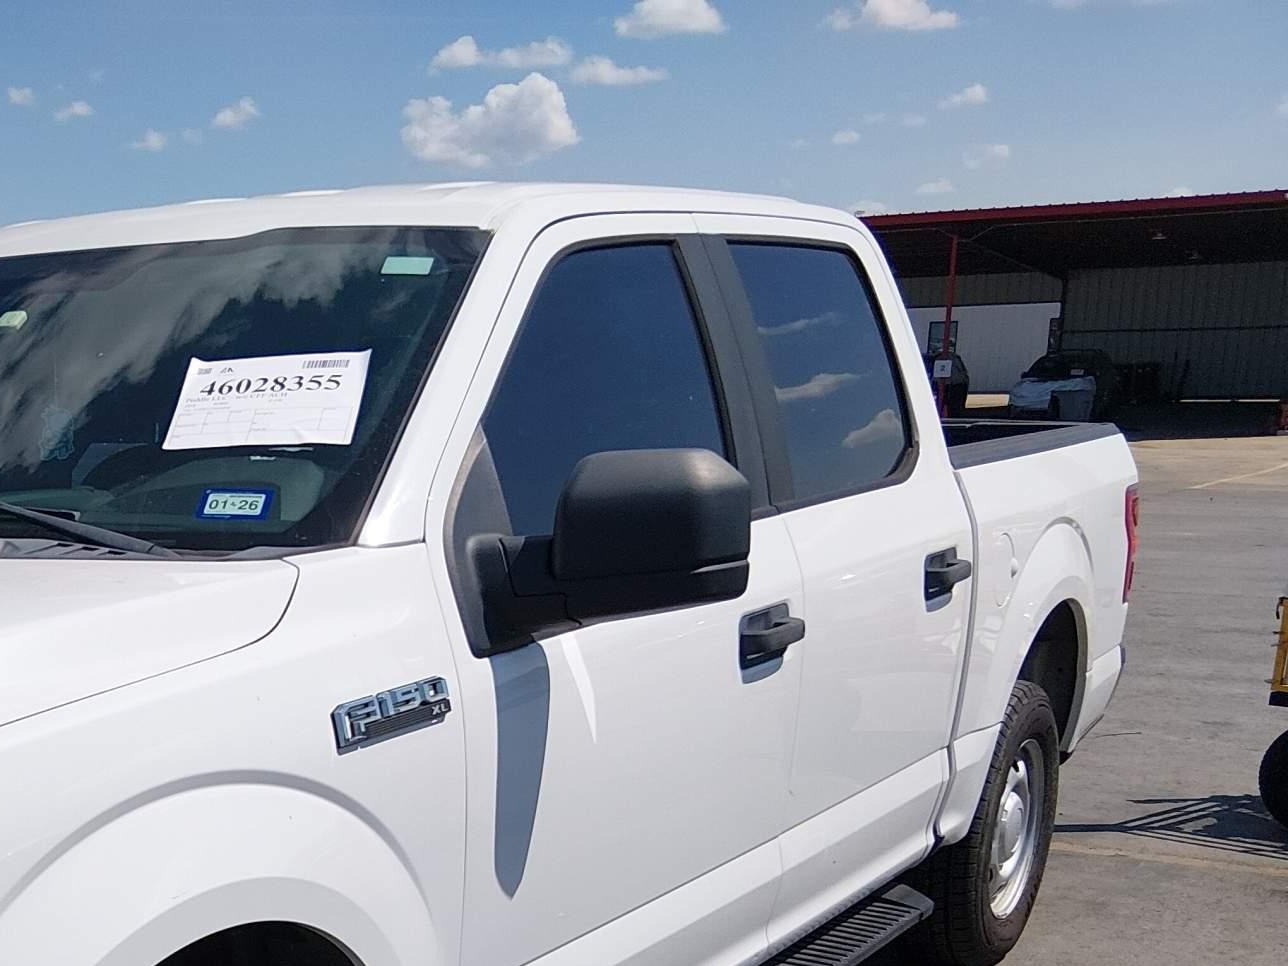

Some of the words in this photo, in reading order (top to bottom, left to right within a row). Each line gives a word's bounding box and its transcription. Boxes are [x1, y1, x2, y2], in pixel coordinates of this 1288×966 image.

[200, 375, 344, 397] 46028355
[208, 499, 229, 510] 01
[237, 499, 260, 511] 26
[431, 703, 449, 715] XL
